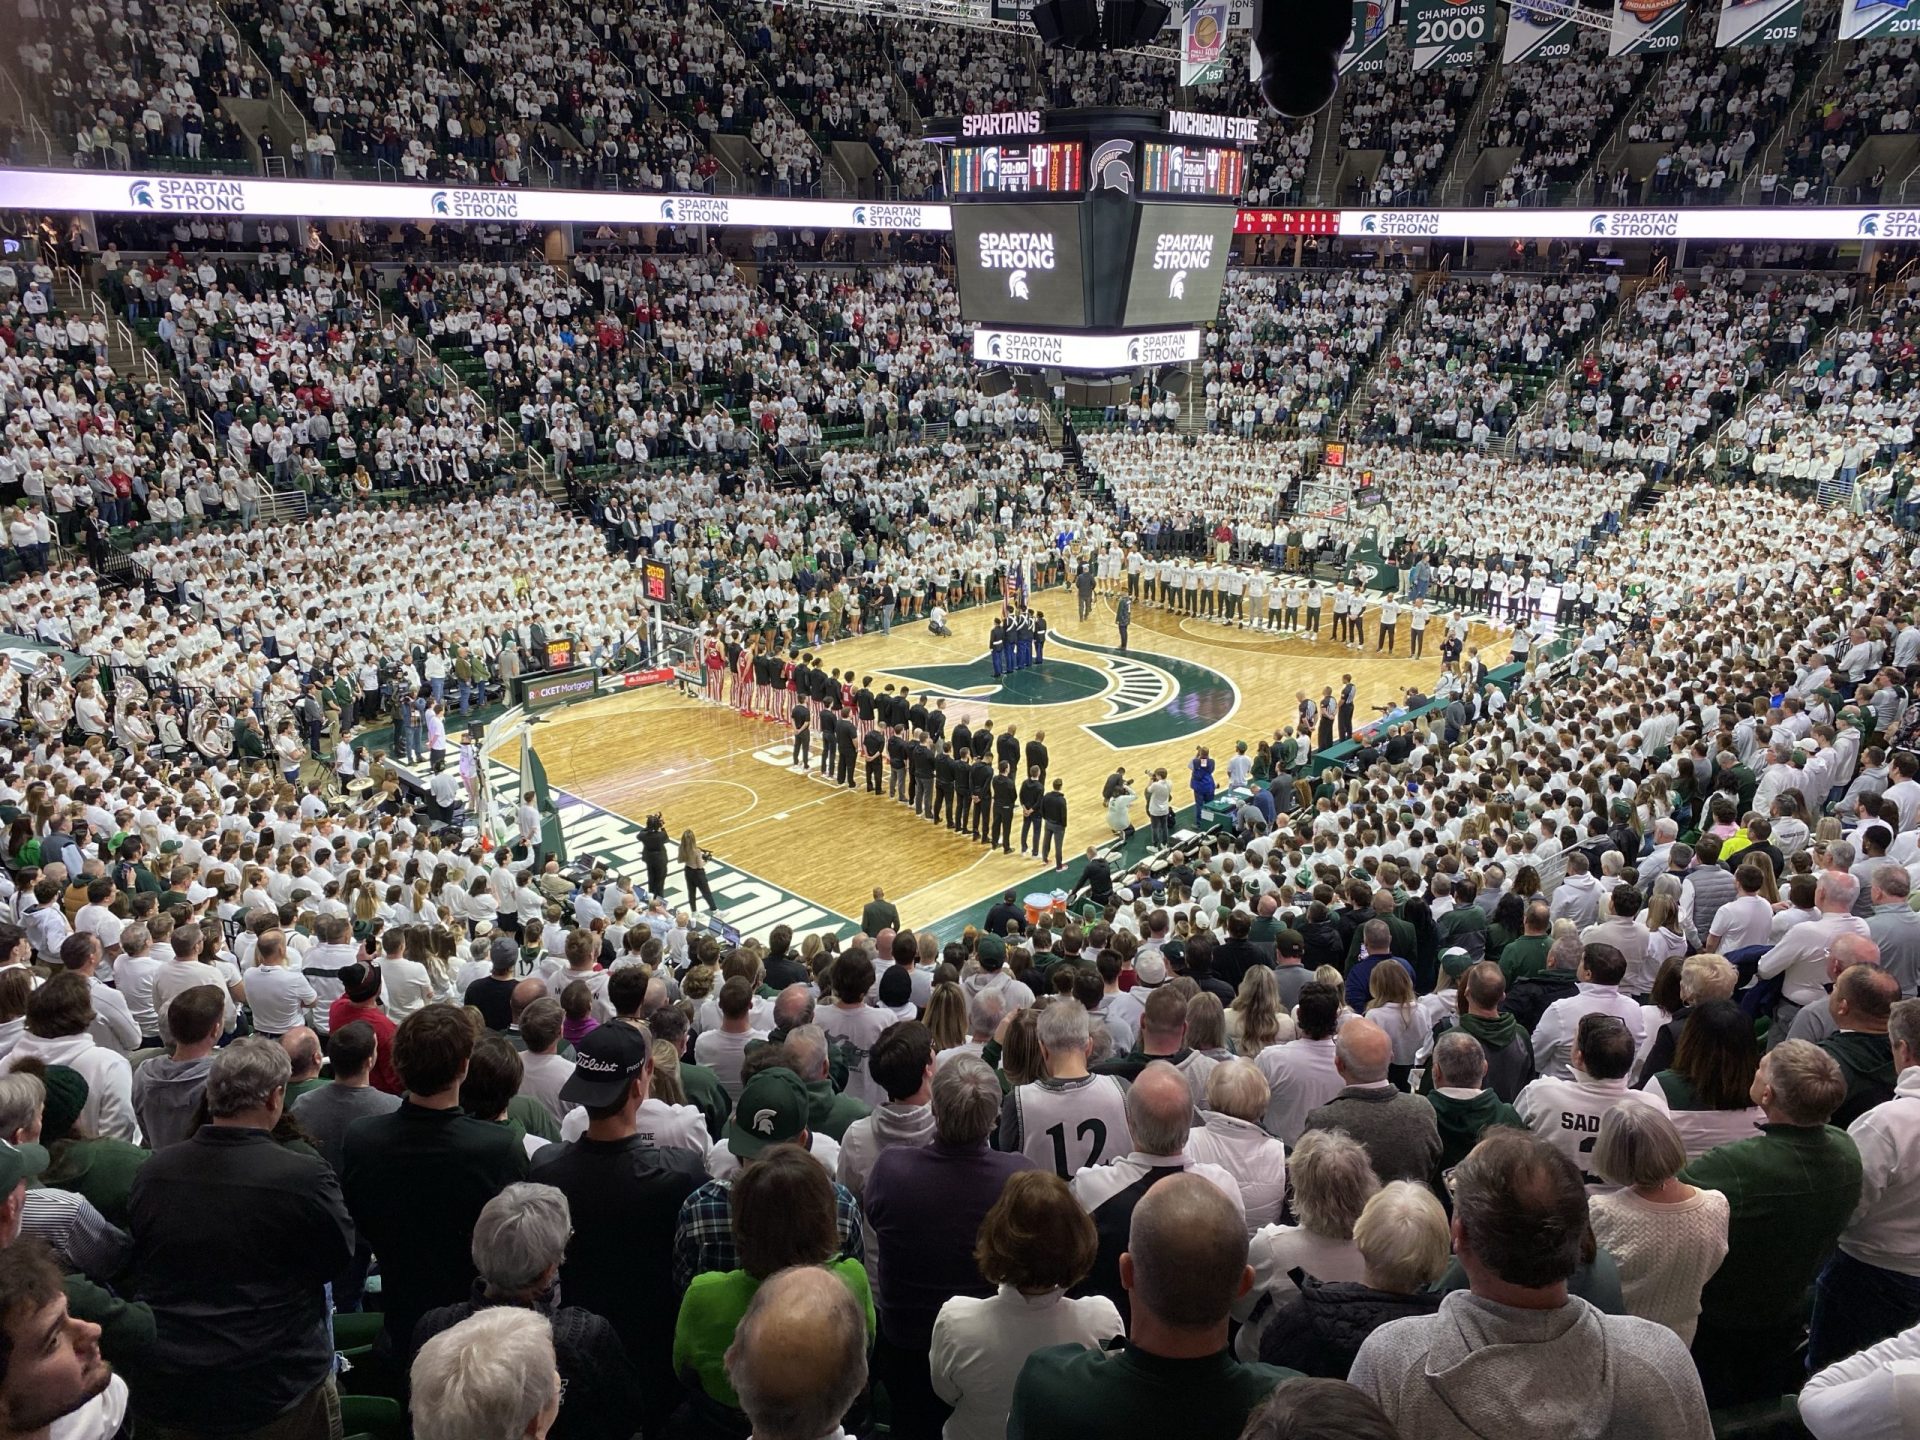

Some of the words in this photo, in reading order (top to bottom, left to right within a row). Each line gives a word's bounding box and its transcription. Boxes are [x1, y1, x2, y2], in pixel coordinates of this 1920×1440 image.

[1418, 5, 1485, 21] CHAMPIONS
[1416, 16, 1484, 44] 2000
[1763, 26, 1796, 41] 2015
[1648, 35, 1679, 49] 2010
[1538, 43, 1571, 57] 2009
[1445, 51, 1473, 64] 2005
[1357, 59, 1383, 72] 2001
[1206, 70, 1223, 80] 1957
[962, 110, 1040, 136] SPARTANS
[1168, 110, 1225, 139] MICHIGAN
[1226, 118, 1260, 141] STATE
[1001, 161, 1028, 174] 20:00
[1184, 163, 1204, 175] 20:00
[158, 179, 243, 197] SPARTAN
[159, 196, 245, 213] STRONG
[453, 191, 517, 205] SPARTAN
[678, 198, 729, 210] SPARTAN
[453, 204, 518, 218] STRONG
[678, 210, 729, 223] STRONG
[869, 206, 921, 217] SPARTAN
[1380, 212, 1439, 224] SPARTAN
[1885, 212, 1920, 224] SPA
[869, 216, 921, 228] STRONG
[1613, 213, 1678, 224] SPARTAN
[1380, 224, 1439, 235] STRONG
[1611, 224, 1677, 236] STRONG
[1882, 224, 1920, 237] STR
[979, 233, 1054, 250] SPARTAN
[1156, 234, 1214, 251] SPARTAN
[981, 250, 1055, 269] STRONG
[1153, 251, 1211, 269] STRONG
[1006, 335, 1062, 349] SPARTAN
[1143, 334, 1186, 349] SPARTAN
[1006, 348, 1062, 364] STRONG
[1142, 347, 1185, 362] STRONG
[646, 564, 665, 579] 20:00
[548, 642, 570, 653] 20:00
[529, 686, 561, 700] ROCKET
[561, 679, 594, 693] Mortgage
[576, 1051, 619, 1072] Titleist
[626, 1062, 640, 1073] PRO
[1046, 1118, 1107, 1182] 12
